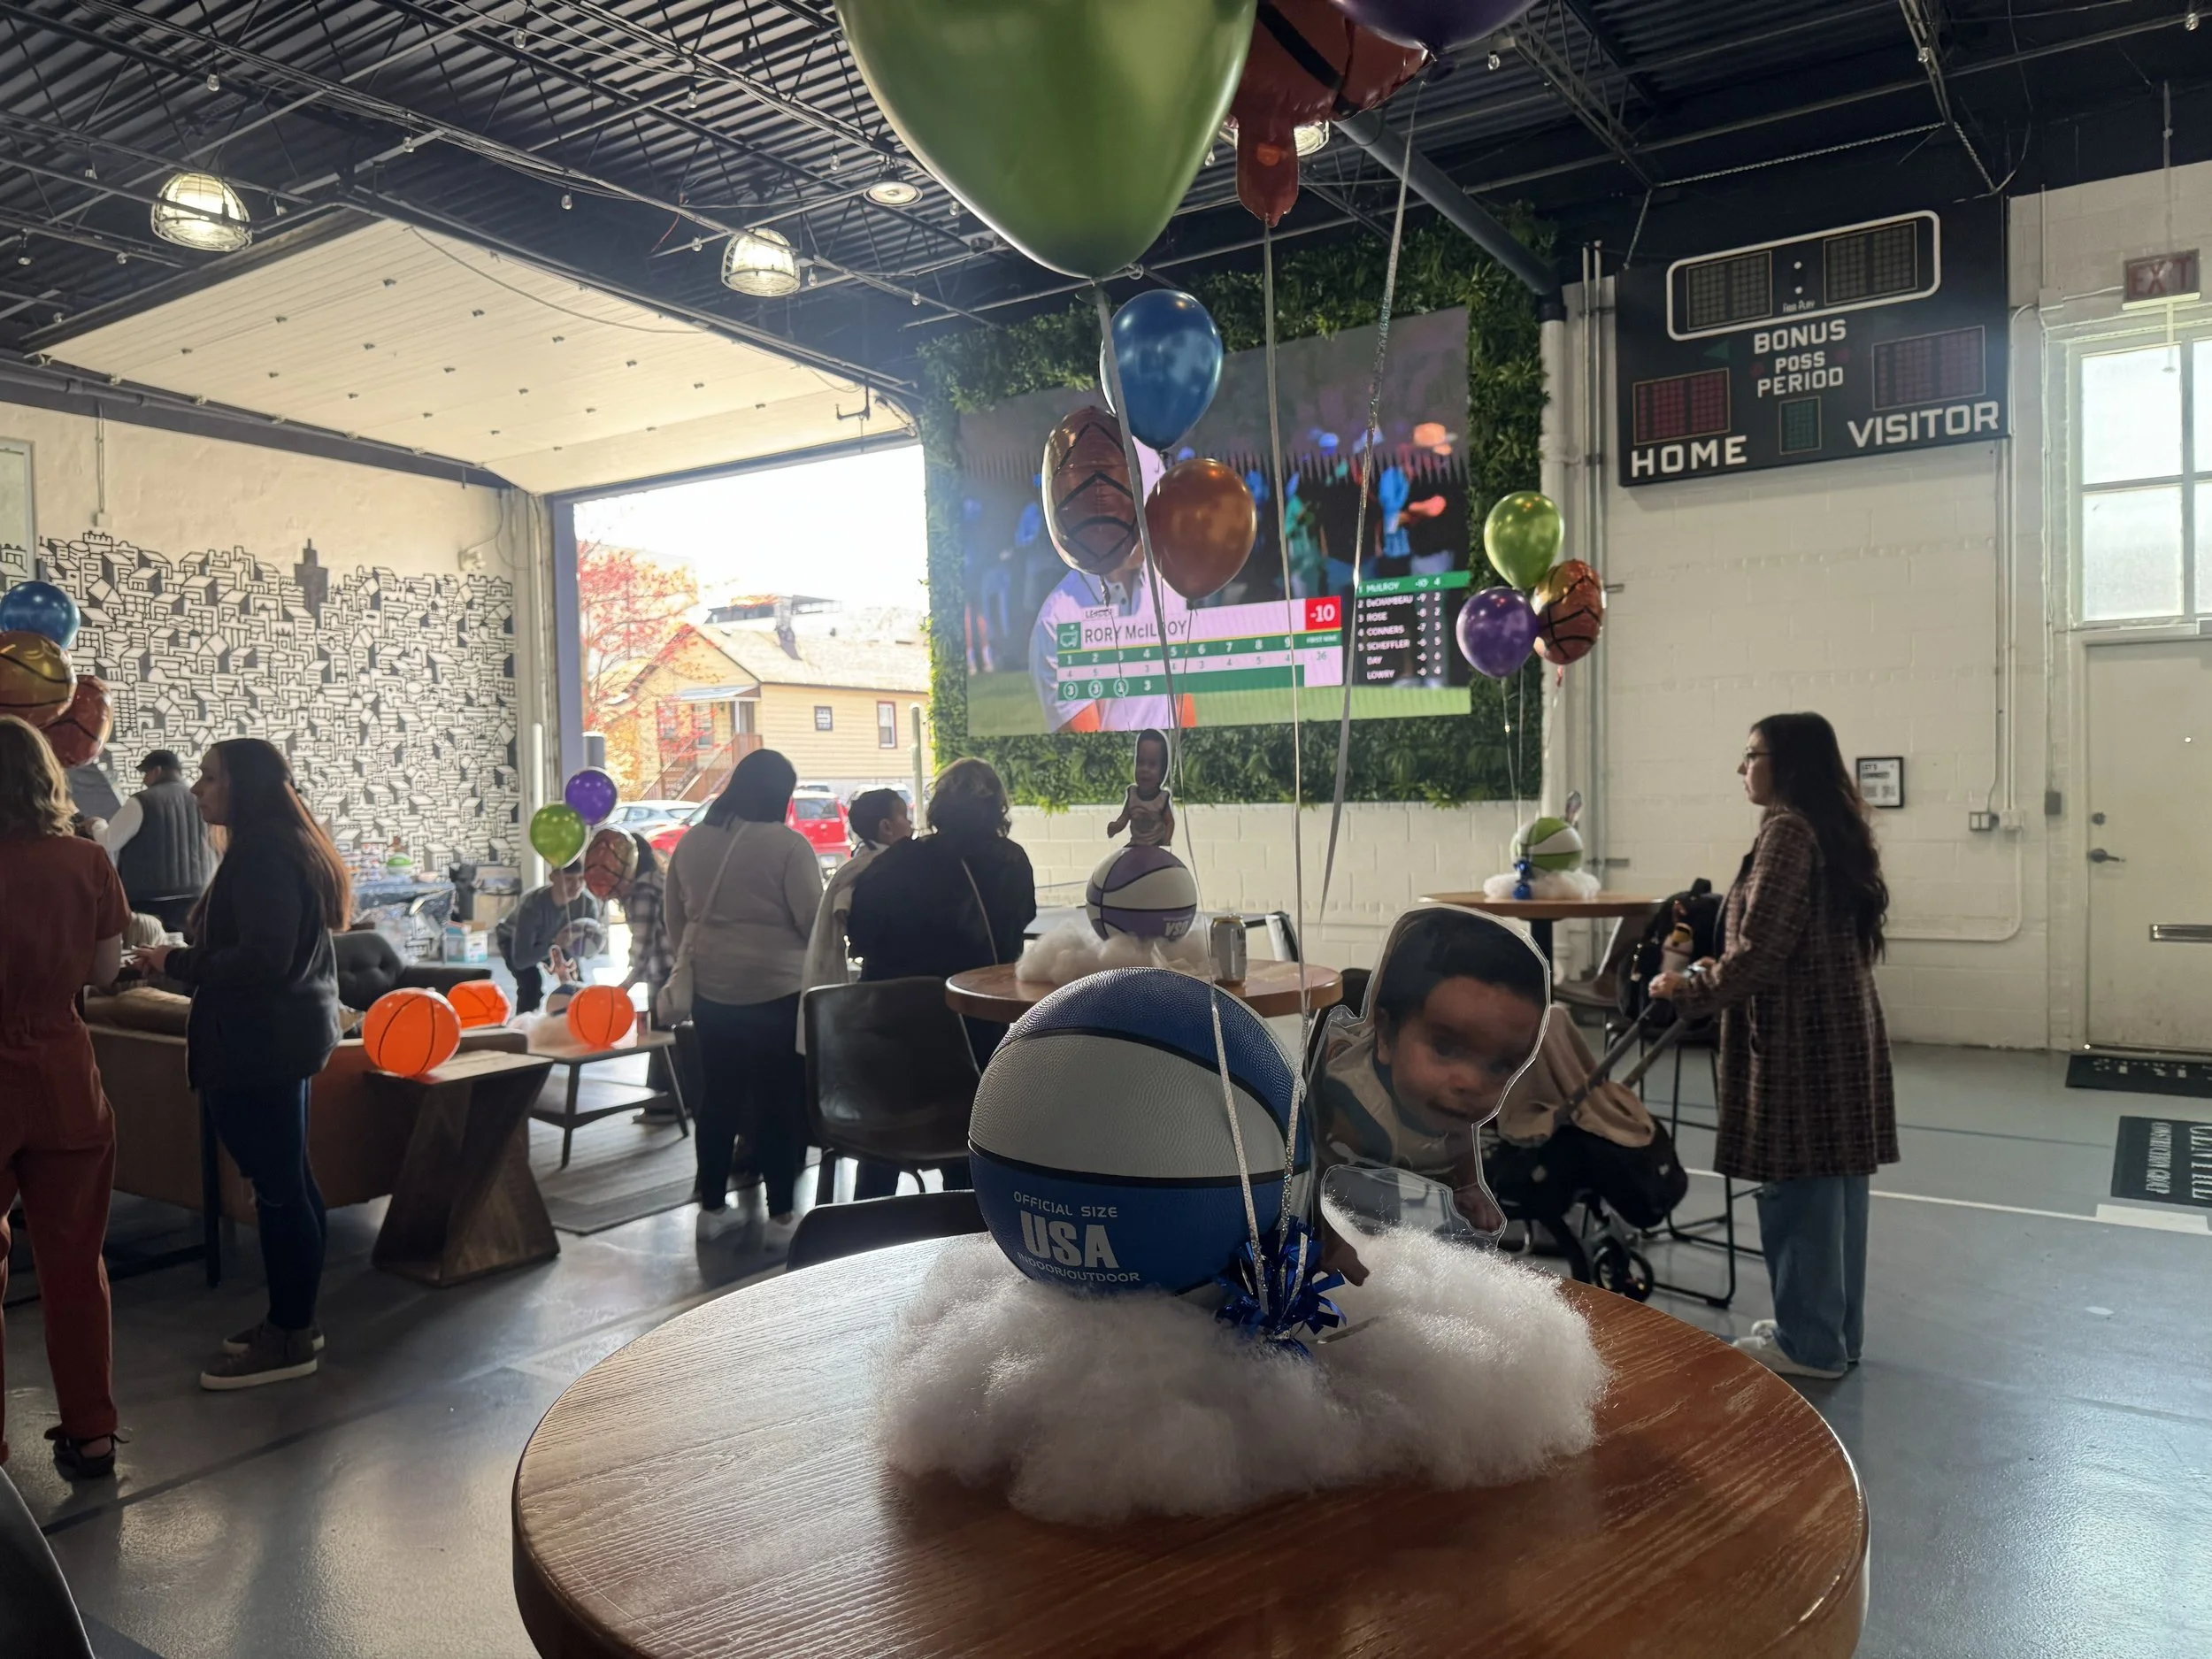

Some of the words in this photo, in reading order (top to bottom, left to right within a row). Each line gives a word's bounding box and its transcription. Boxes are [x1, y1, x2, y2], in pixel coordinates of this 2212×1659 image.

[1754, 319, 1847, 354] BONUS
[1775, 350, 1825, 374] POSS
[1757, 366, 1844, 398] PERIOD
[1847, 400, 1999, 448] VISITOR
[1632, 434, 1747, 478] HOME
[1357, 599, 1364, 609] 2
[1434, 592, 1441, 601] 2
[1310, 604, 1335, 622] -10
[1357, 614, 1364, 623] 3
[1366, 611, 1388, 622] ROSE
[1434, 607, 1441, 616] 2
[1085, 626, 1122, 643] RORY
[1125, 620, 1187, 640] McILOY
[1366, 625, 1405, 636] CONNERS
[1067, 655, 1072, 664] 1
[1092, 653, 1099, 663] 2
[1118, 650, 1124, 661] 3
[1143, 649, 1150, 658] 4
[1170, 647, 1178, 657] 5
[1198, 644, 1206, 655] 6
[1225, 641, 1233, 652] 7
[1255, 639, 1263, 650] 8
[1284, 637, 1291, 649] 9
[1357, 642, 1364, 652] 5
[1366, 639, 1410, 651] SCHEFFLER
[1366, 656, 1383, 665] DAY
[1366, 669, 1396, 680] LOWRY
[1067, 685, 1074, 695] 3
[1093, 683, 1100, 694] 3
[1144, 680, 1151, 691] 3
[1013, 1191, 1073, 1216] OFFICIAL
[1080, 1206, 1118, 1217] SIZE
[1020, 1210, 1120, 1269] USA
[1018, 1251, 1141, 1282] INDOOR/OUTDOOR
